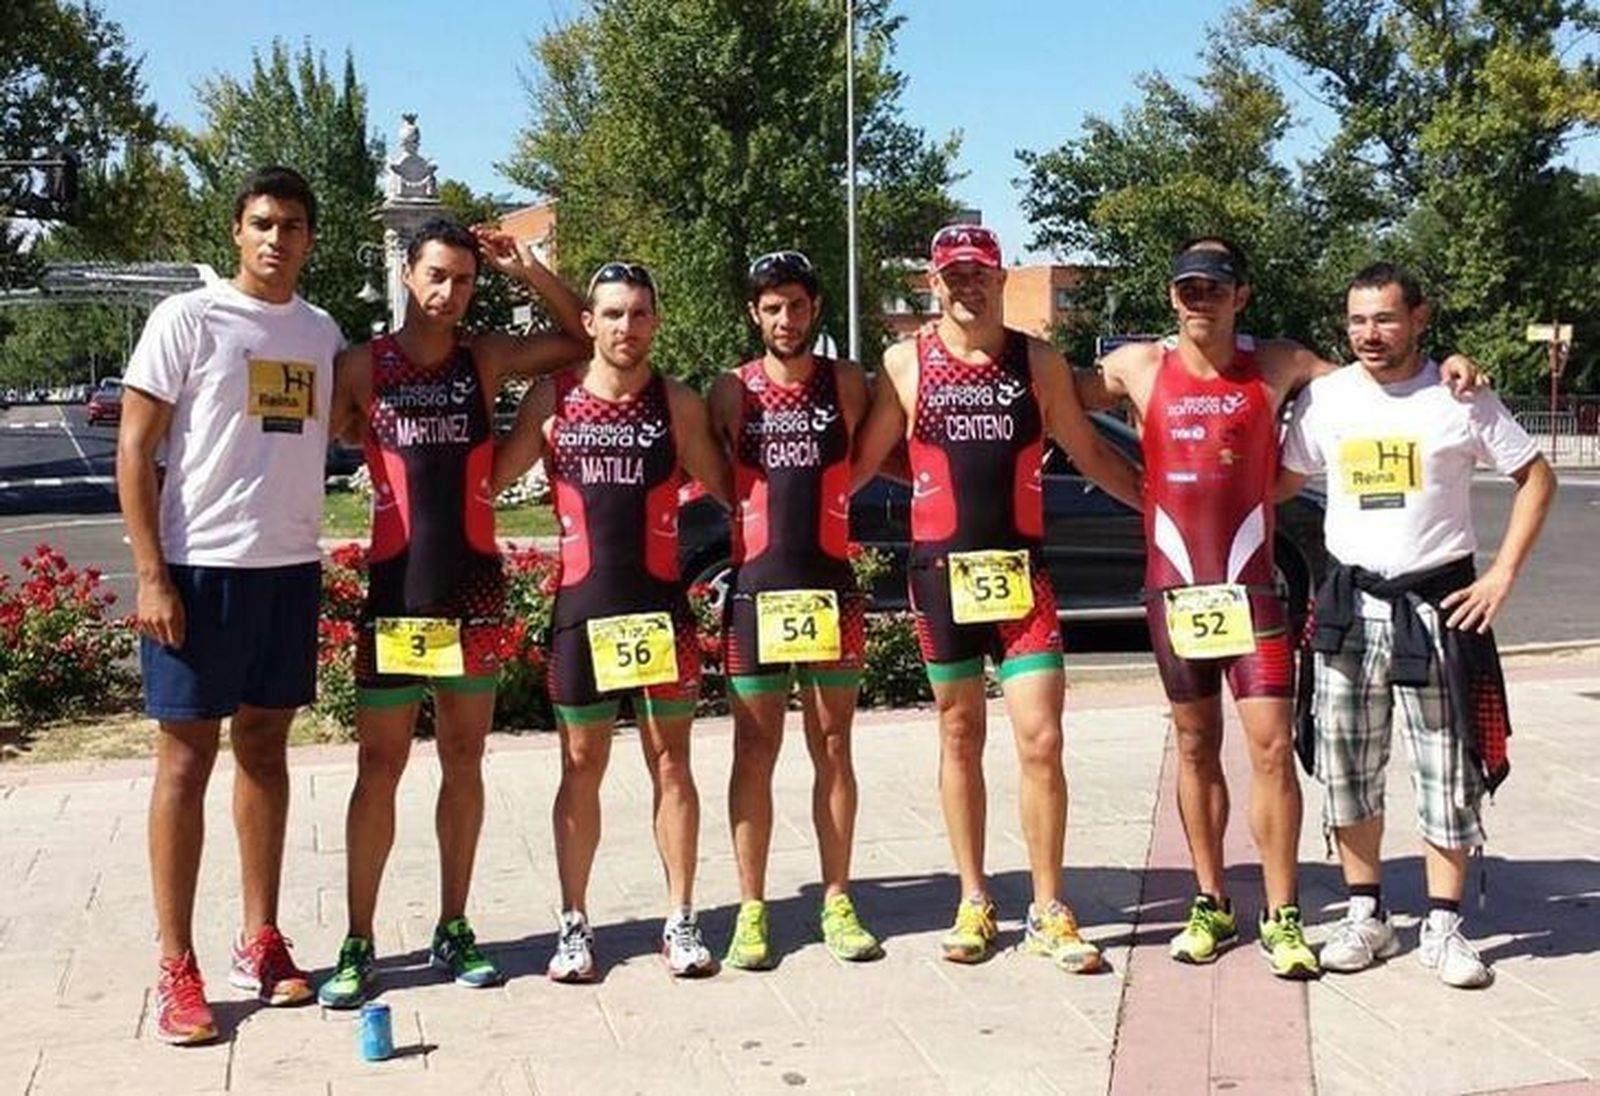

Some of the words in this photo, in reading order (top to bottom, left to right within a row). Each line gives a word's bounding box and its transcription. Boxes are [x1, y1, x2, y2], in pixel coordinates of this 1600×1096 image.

[927, 392, 994, 407] zamora
[558, 431, 635, 447] zamora
[945, 414, 1014, 441] CENTENO
[581, 456, 645, 485] MATILLA
[1351, 469, 1396, 485] Reina
[974, 575, 1010, 602] 53
[782, 616, 818, 642] 54
[1191, 611, 1229, 638] 52
[410, 634, 426, 658] 3
[616, 640, 651, 668] 56
